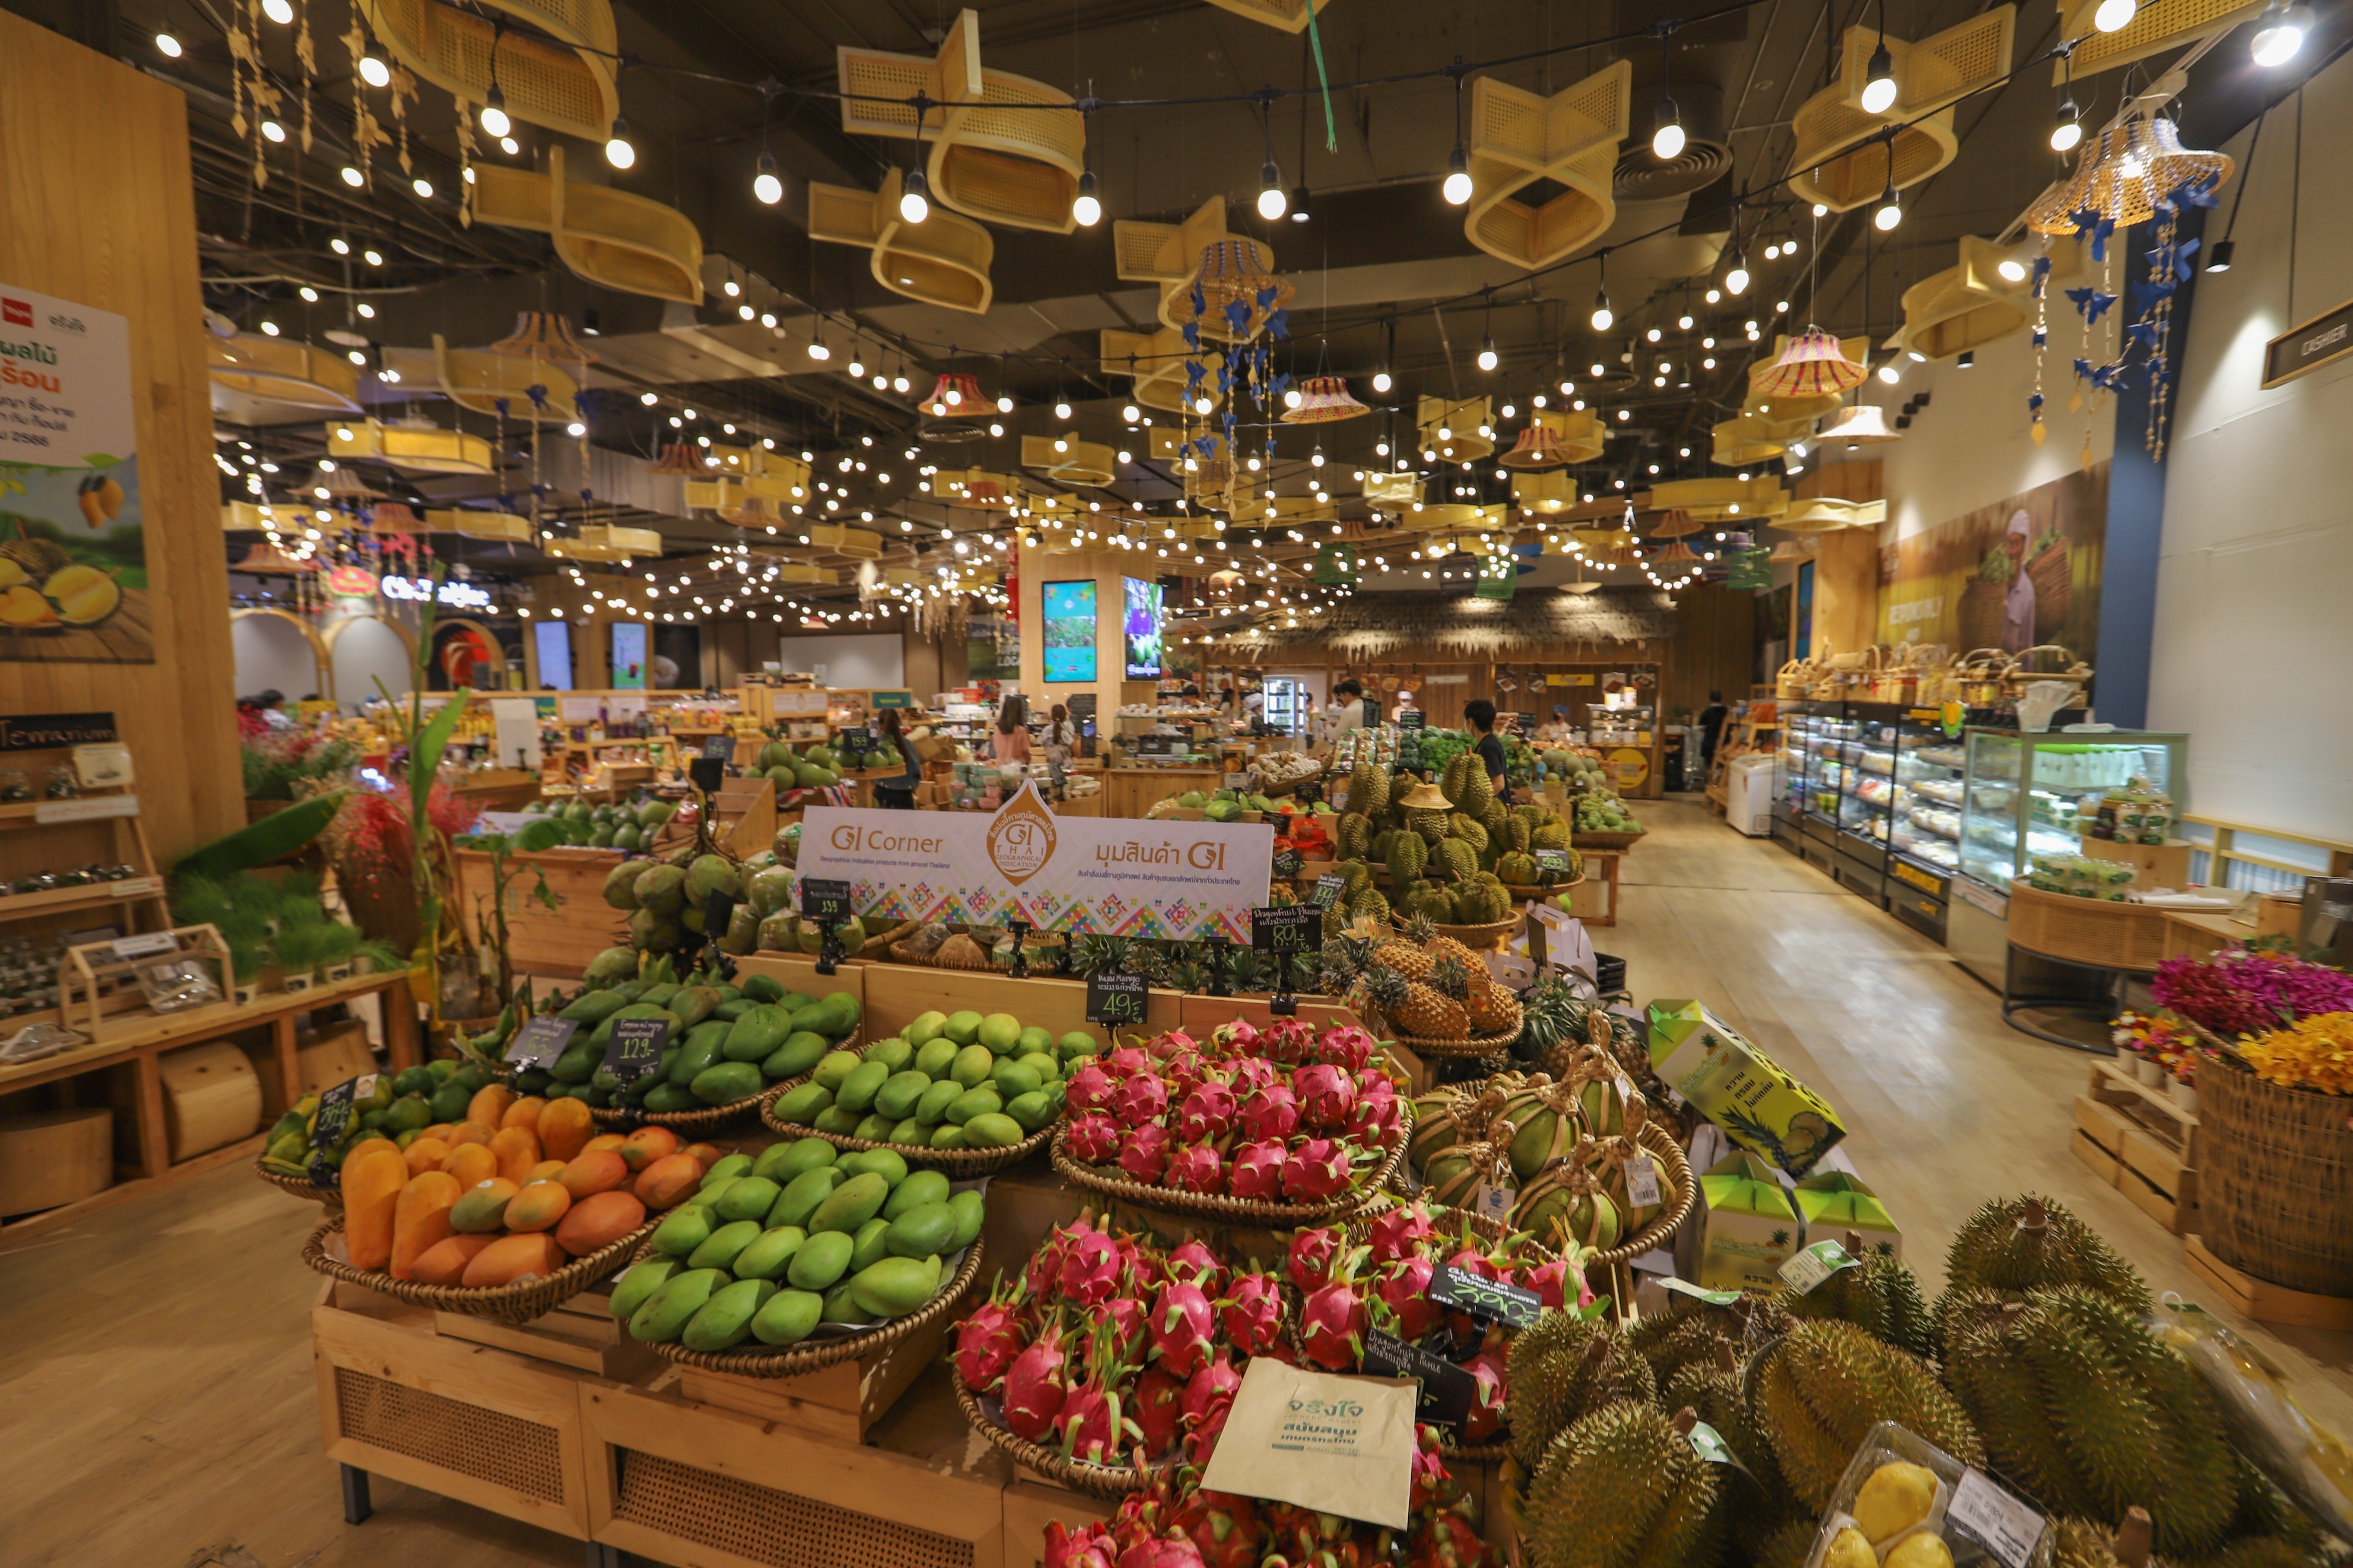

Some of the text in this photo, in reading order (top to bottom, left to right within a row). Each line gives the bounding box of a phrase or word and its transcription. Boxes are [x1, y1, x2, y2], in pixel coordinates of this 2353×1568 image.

[831, 825, 943, 853] GI Corner
[1005, 823, 1033, 845] GI
[1095, 841, 1226, 870] มุมสินค้า GI
[1116, 974, 1140, 985] Mango
[1368, 1329, 1415, 1362] Dragonfruit
[1284, 1422, 1357, 1437] สนับสนุน
